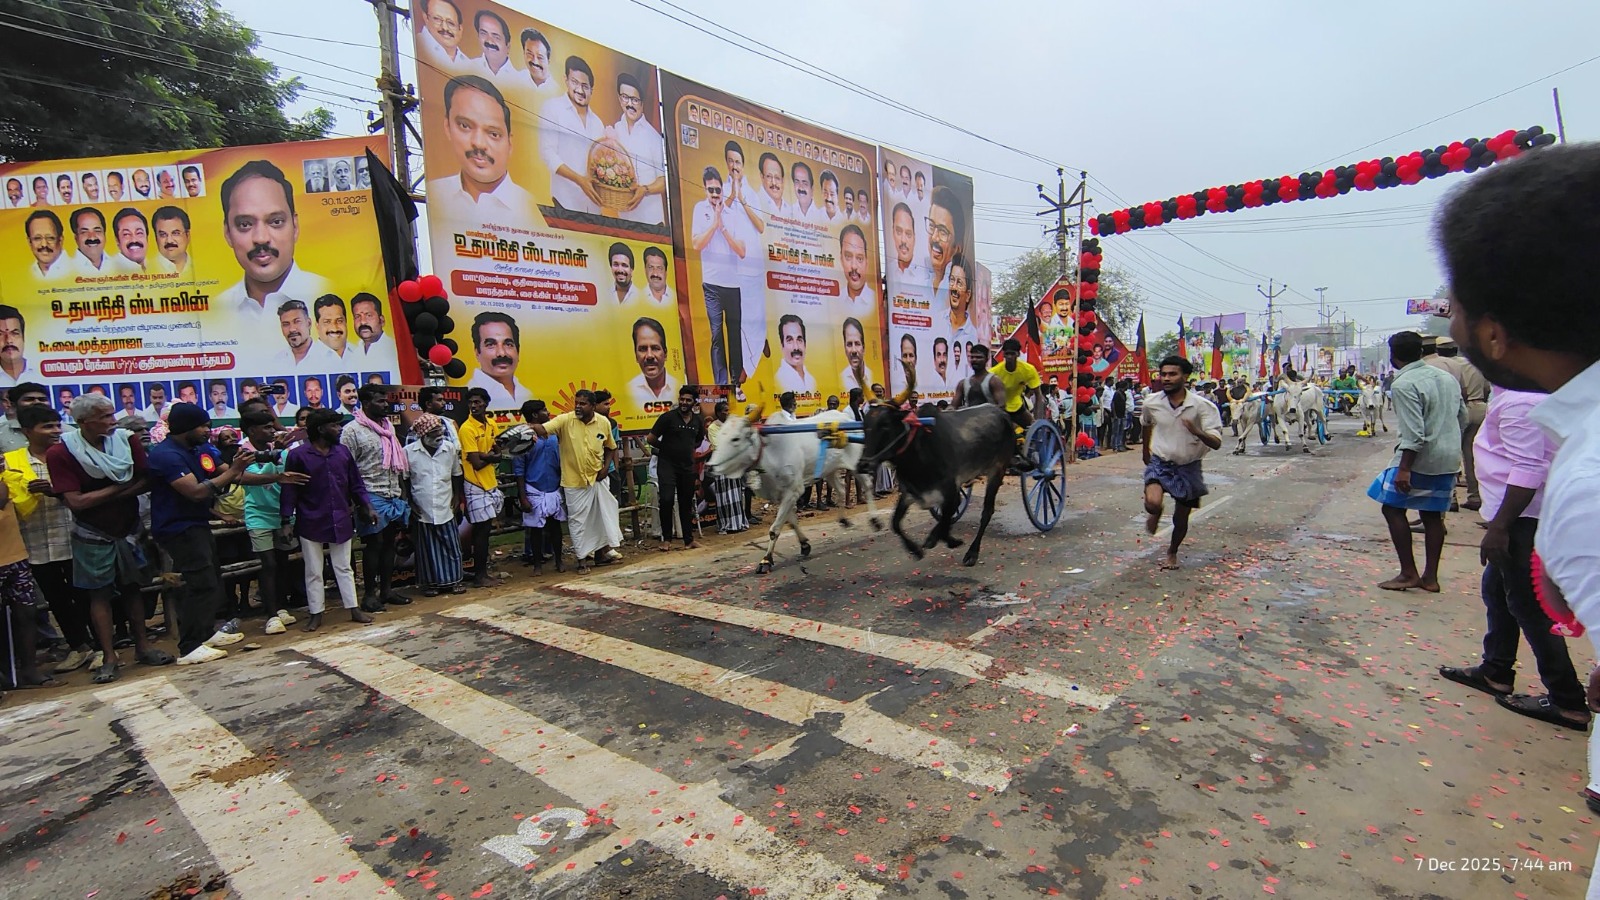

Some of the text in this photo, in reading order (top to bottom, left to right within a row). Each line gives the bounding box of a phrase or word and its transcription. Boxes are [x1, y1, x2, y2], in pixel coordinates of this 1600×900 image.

[322, 196, 367, 205] 30.11.2025
[331, 206, 360, 216] ஞாயிறு
[454, 234, 588, 268] உதயநிதி ஸ்டாலின்
[768, 244, 834, 267] உதயநிதி ஸ்டாலின்
[75, 272, 179, 284] இளைஞர்களின் இதய நாயகன்
[462, 274, 511, 286] மாட்டுவண்டி,
[512, 278, 558, 289] குதிரைவண்டி
[520, 290, 551, 300] சைக்கிள்
[552, 292, 578, 302] பந்தயம்
[51, 290, 209, 323] உதயநிதி ஸ்டாலின்
[44, 360, 83, 373] மாபெரும்
[84, 359, 116, 372] ரேக்ளா
[139, 356, 196, 370] குதிரைவண்டி
[197, 354, 230, 369] பந்தயம்
